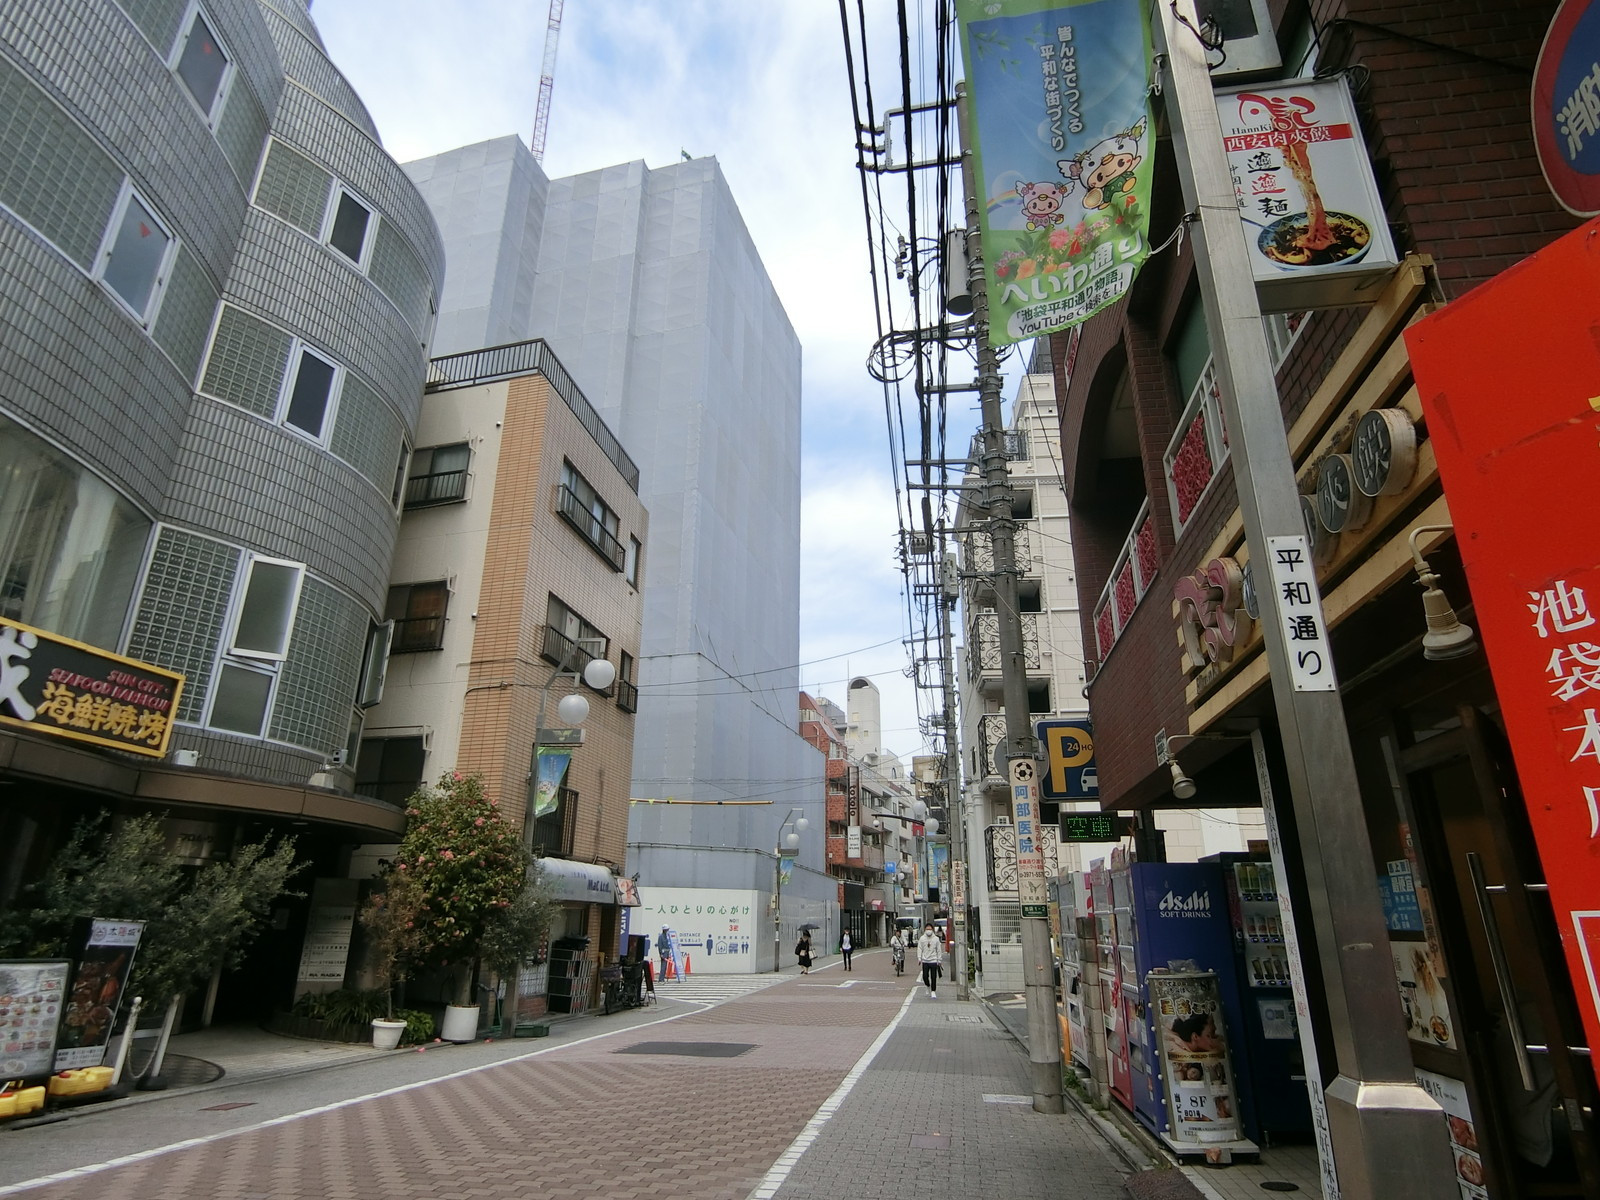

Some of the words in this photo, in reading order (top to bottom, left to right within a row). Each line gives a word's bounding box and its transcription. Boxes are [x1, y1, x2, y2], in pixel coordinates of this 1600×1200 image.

[1057, 26, 1083, 133] 皆んなでつくる
[1040, 45, 1064, 152] 平和な街づくり
[1232, 122, 1272, 136] HannKi
[1001, 234, 1142, 304] へいわ通り
[1016, 268, 1124, 322] 「池袋平和通り物語」
[1276, 549, 1322, 675] 平和通り
[48, 668, 112, 696] SEAFOOD
[107, 670, 136, 688] SUN
[138, 679, 164, 696] CITY
[1046, 727, 1094, 793] P
[1066, 742, 1080, 752] 24
[1014, 785, 1034, 854] 阿部医院
[1067, 816, 1113, 838] 空車
[645, 904, 750, 915] 一人ひとりの心がけ
[1158, 890, 1210, 911] Asahi
[1190, 1096, 1208, 1108] 8F
